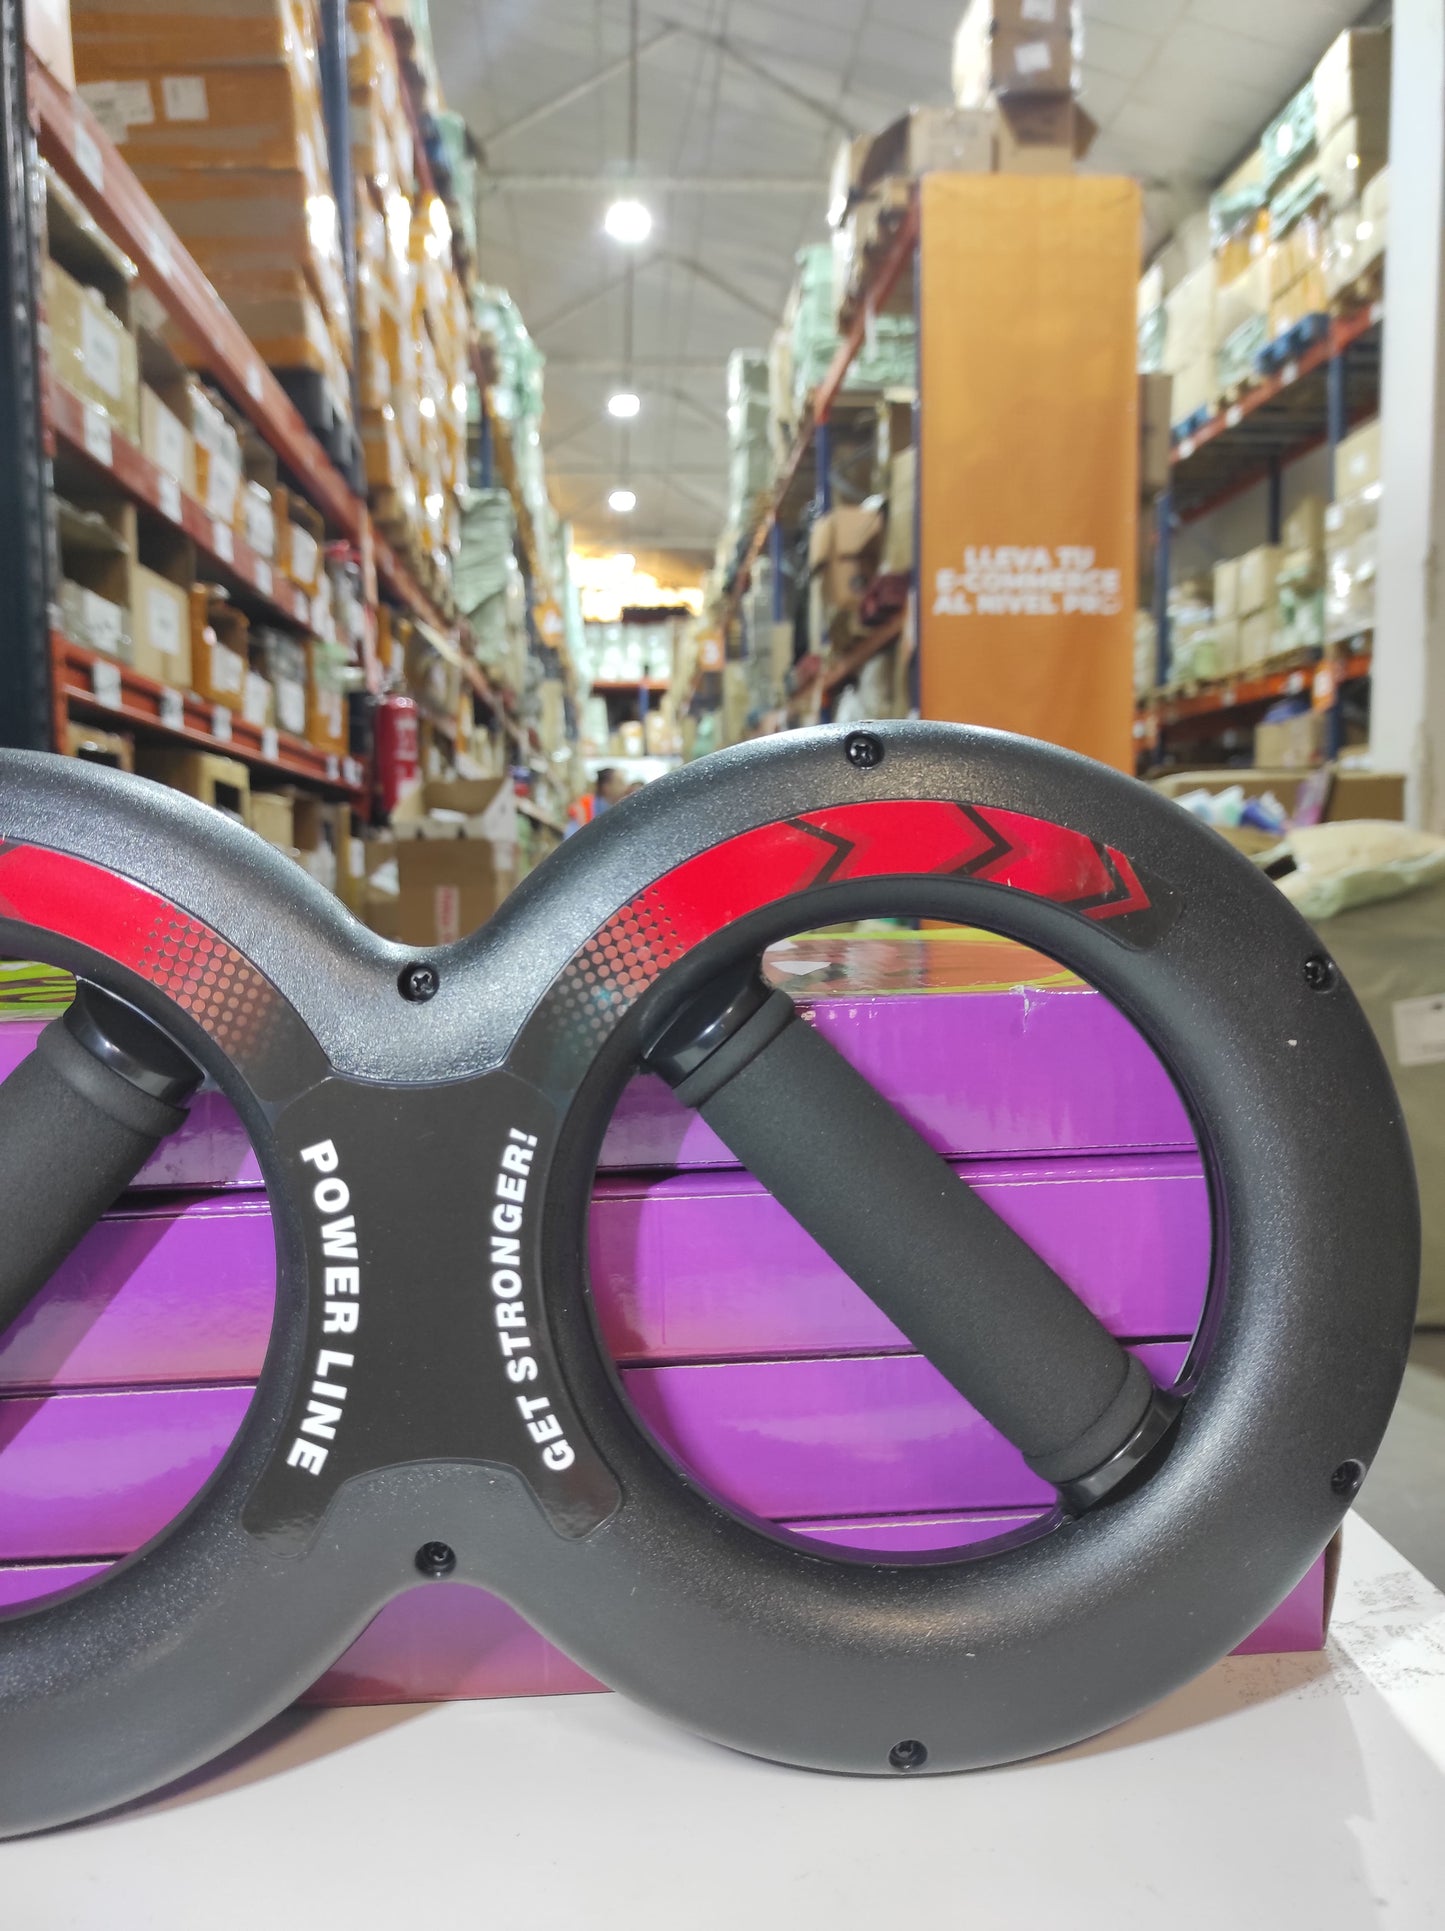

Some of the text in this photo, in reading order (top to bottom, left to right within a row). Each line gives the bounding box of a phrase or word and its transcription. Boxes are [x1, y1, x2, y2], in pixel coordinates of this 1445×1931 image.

[964, 546, 1096, 570] LLEVA TU
[936, 568, 1121, 593] E-COMMERCE
[932, 592, 971, 616] AL
[976, 592, 1058, 616] NIVEL
[286, 1138, 360, 1476] POWER LINE
[490, 1127, 576, 1471] GET STRONGER!
